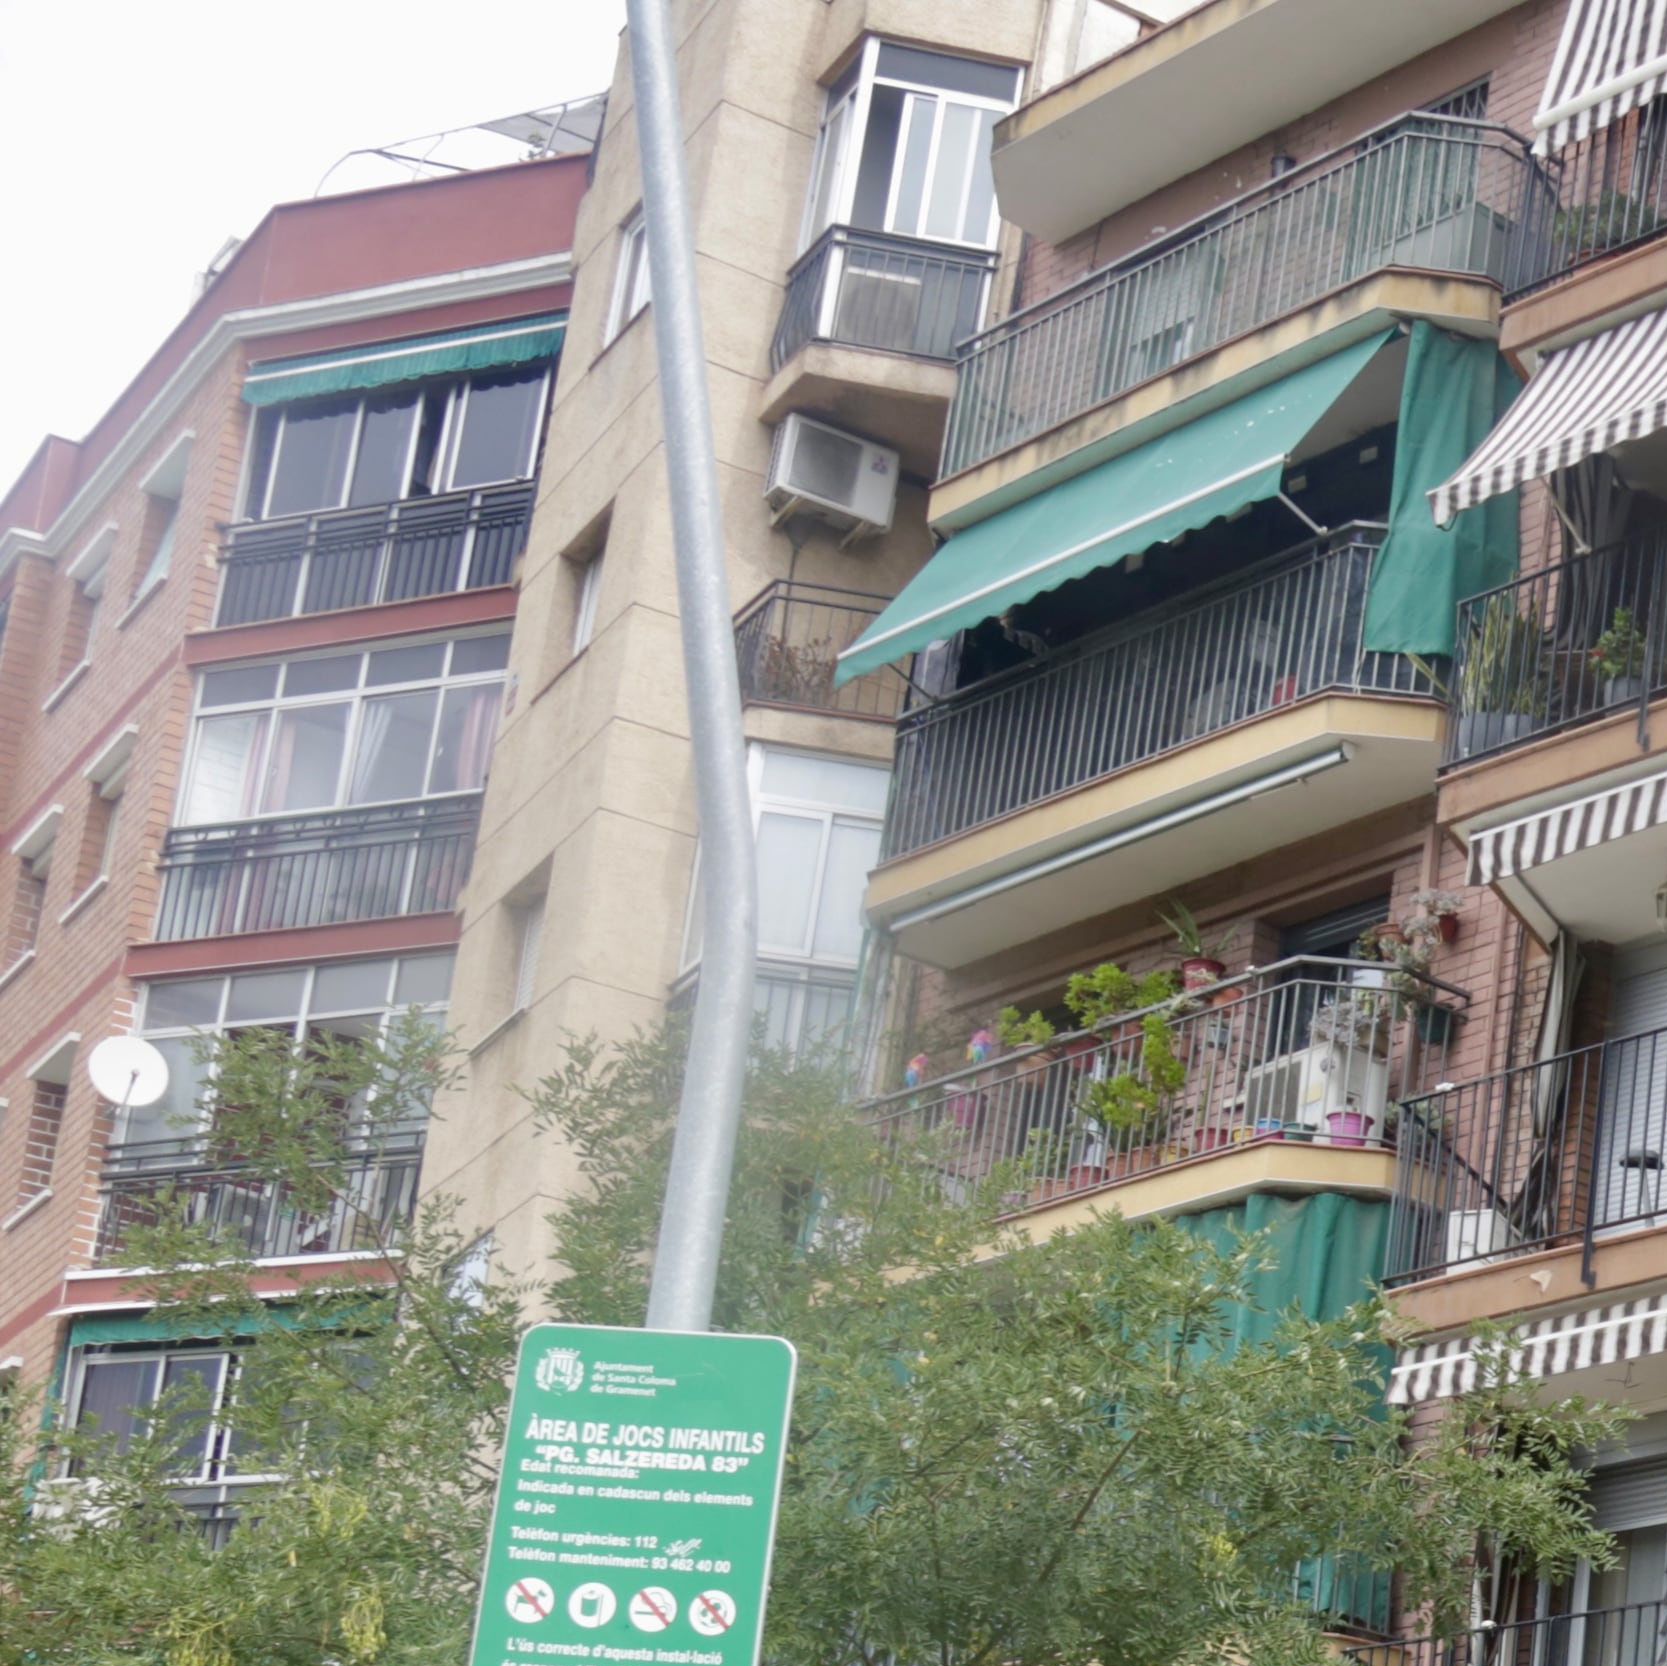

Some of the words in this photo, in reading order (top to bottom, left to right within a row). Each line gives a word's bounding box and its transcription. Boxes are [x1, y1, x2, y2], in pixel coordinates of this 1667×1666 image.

[593, 1361, 654, 1373] Ajuntament
[592, 1373, 605, 1382] de
[607, 1373, 636, 1384] Santa
[638, 1375, 677, 1386] Coloma
[590, 1384, 604, 1393] de
[606, 1385, 656, 1396] Gramenet
[525, 1413, 578, 1442] ÀREA
[582, 1421, 610, 1444] DE
[613, 1424, 664, 1449] JOCS
[669, 1428, 765, 1454] INFANTILS
[521, 1459, 552, 1473] Edat
[554, 1461, 640, 1479] recomanada:
[585, 1448, 707, 1471] SALZEREDA
[517, 1479, 575, 1496] Indicada
[577, 1484, 594, 1496] en
[597, 1485, 661, 1501] cadascun
[663, 1488, 691, 1503] dels
[693, 1492, 753, 1507] elements
[514, 1499, 531, 1512] de
[534, 1500, 556, 1514] joc
[511, 1526, 559, 1542] Telèfon
[562, 1530, 631, 1547] urgències:
[634, 1536, 658, 1548] 112
[508, 1546, 556, 1562] Telèfon
[559, 1550, 648, 1569] manteniment:
[651, 1557, 667, 1570] 93
[670, 1558, 693, 1571] 462
[696, 1560, 712, 1573] 40
[714, 1561, 731, 1574] 00
[537, 1641, 590, 1657] correcte
[592, 1644, 654, 1661] d'aquesta
